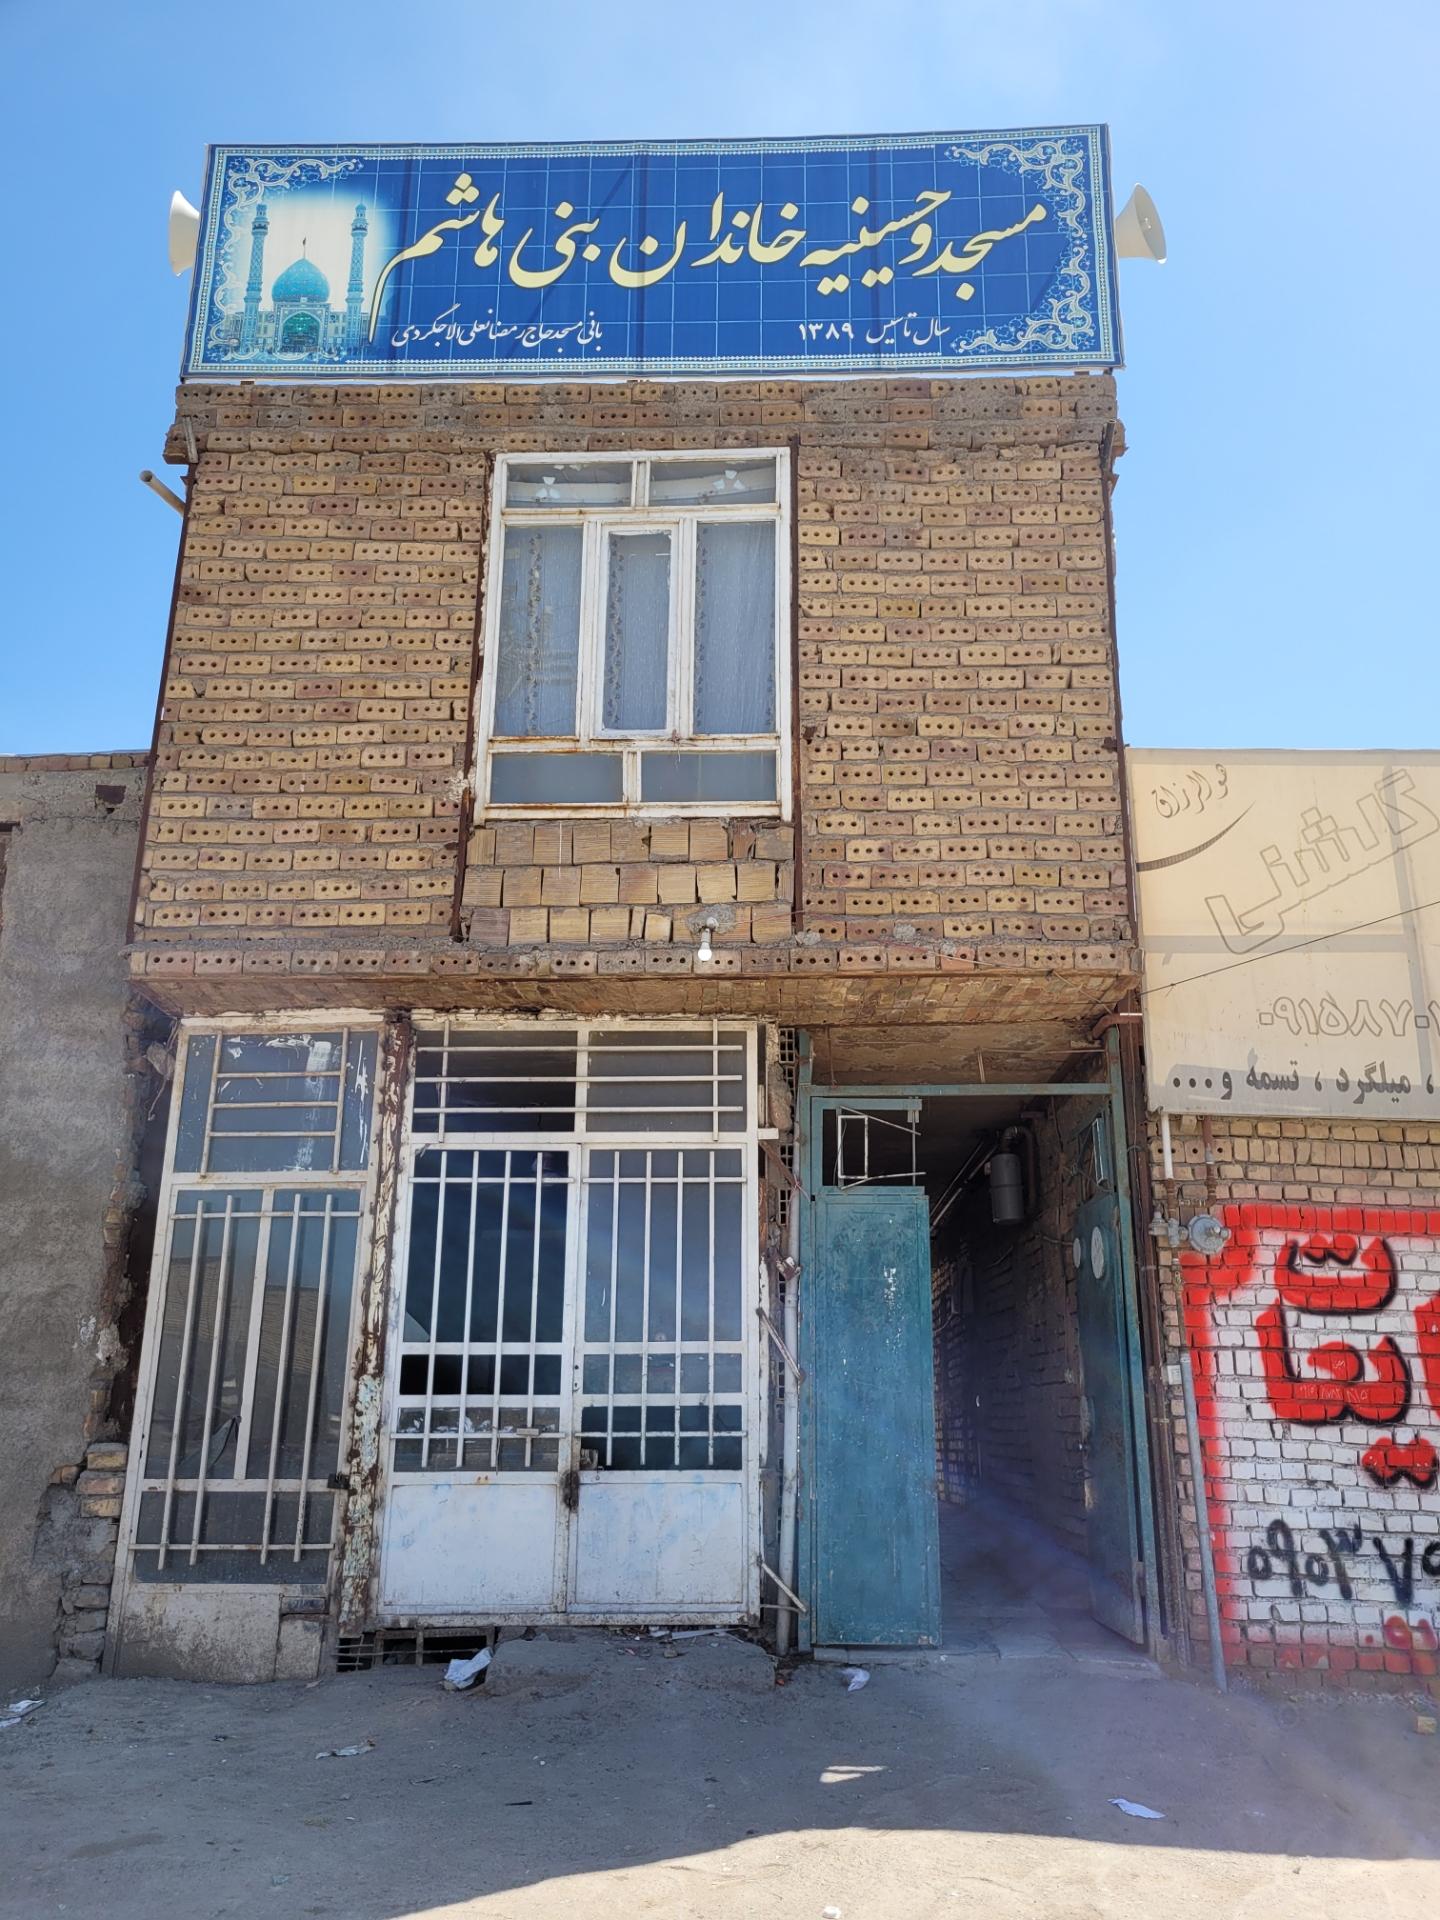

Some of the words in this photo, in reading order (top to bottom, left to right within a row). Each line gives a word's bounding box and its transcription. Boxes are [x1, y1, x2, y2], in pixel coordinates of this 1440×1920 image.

[368, 172, 505, 344] هاشم
[508, 201, 601, 288] بنی
[608, 191, 807, 288] خاندان
[799, 190, 952, 296] حسینیه
[912, 202, 1047, 300] مسجد
[522, 322, 552, 347] حاج
[549, 320, 583, 353] مسجد
[577, 311, 603, 352] بانی
[799, 322, 854, 341] ۱۳۸۹
[913, 317, 951, 345] سال
[1259, 996, 1440, 1037] ۰۹۱۵۸۷۰
